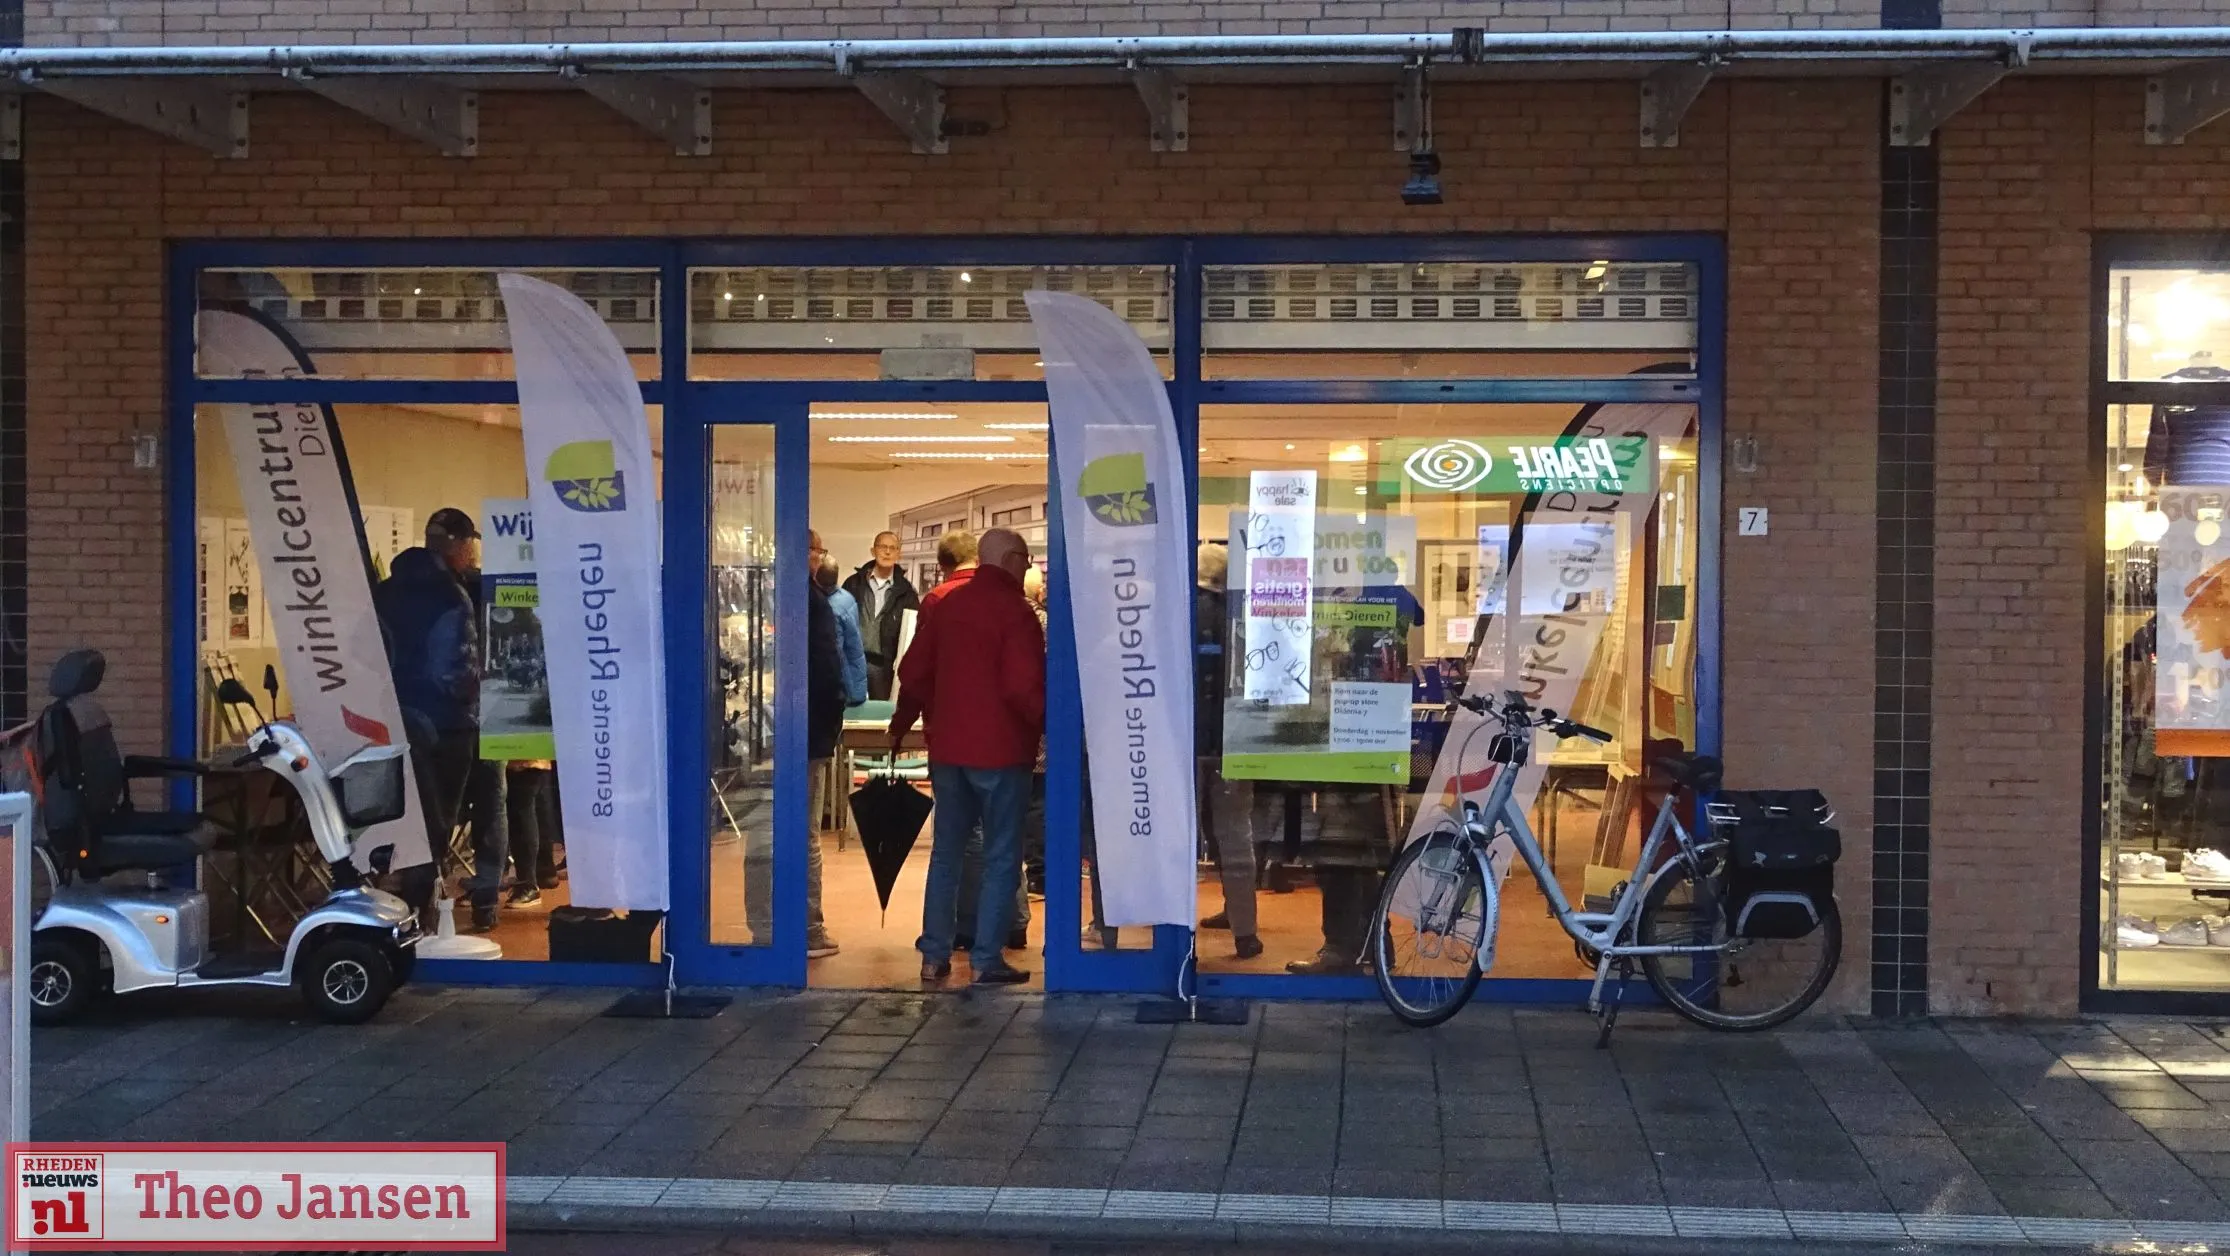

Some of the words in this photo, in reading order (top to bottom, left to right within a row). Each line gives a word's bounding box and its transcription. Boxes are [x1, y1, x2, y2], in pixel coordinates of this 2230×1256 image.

[491, 511, 534, 542] Wij
[1747, 511, 1758, 532] 7
[1314, 529, 1383, 549] omen
[1333, 557, 1349, 574] u
[501, 590, 538, 603] Winke
[1369, 687, 1379, 695] de
